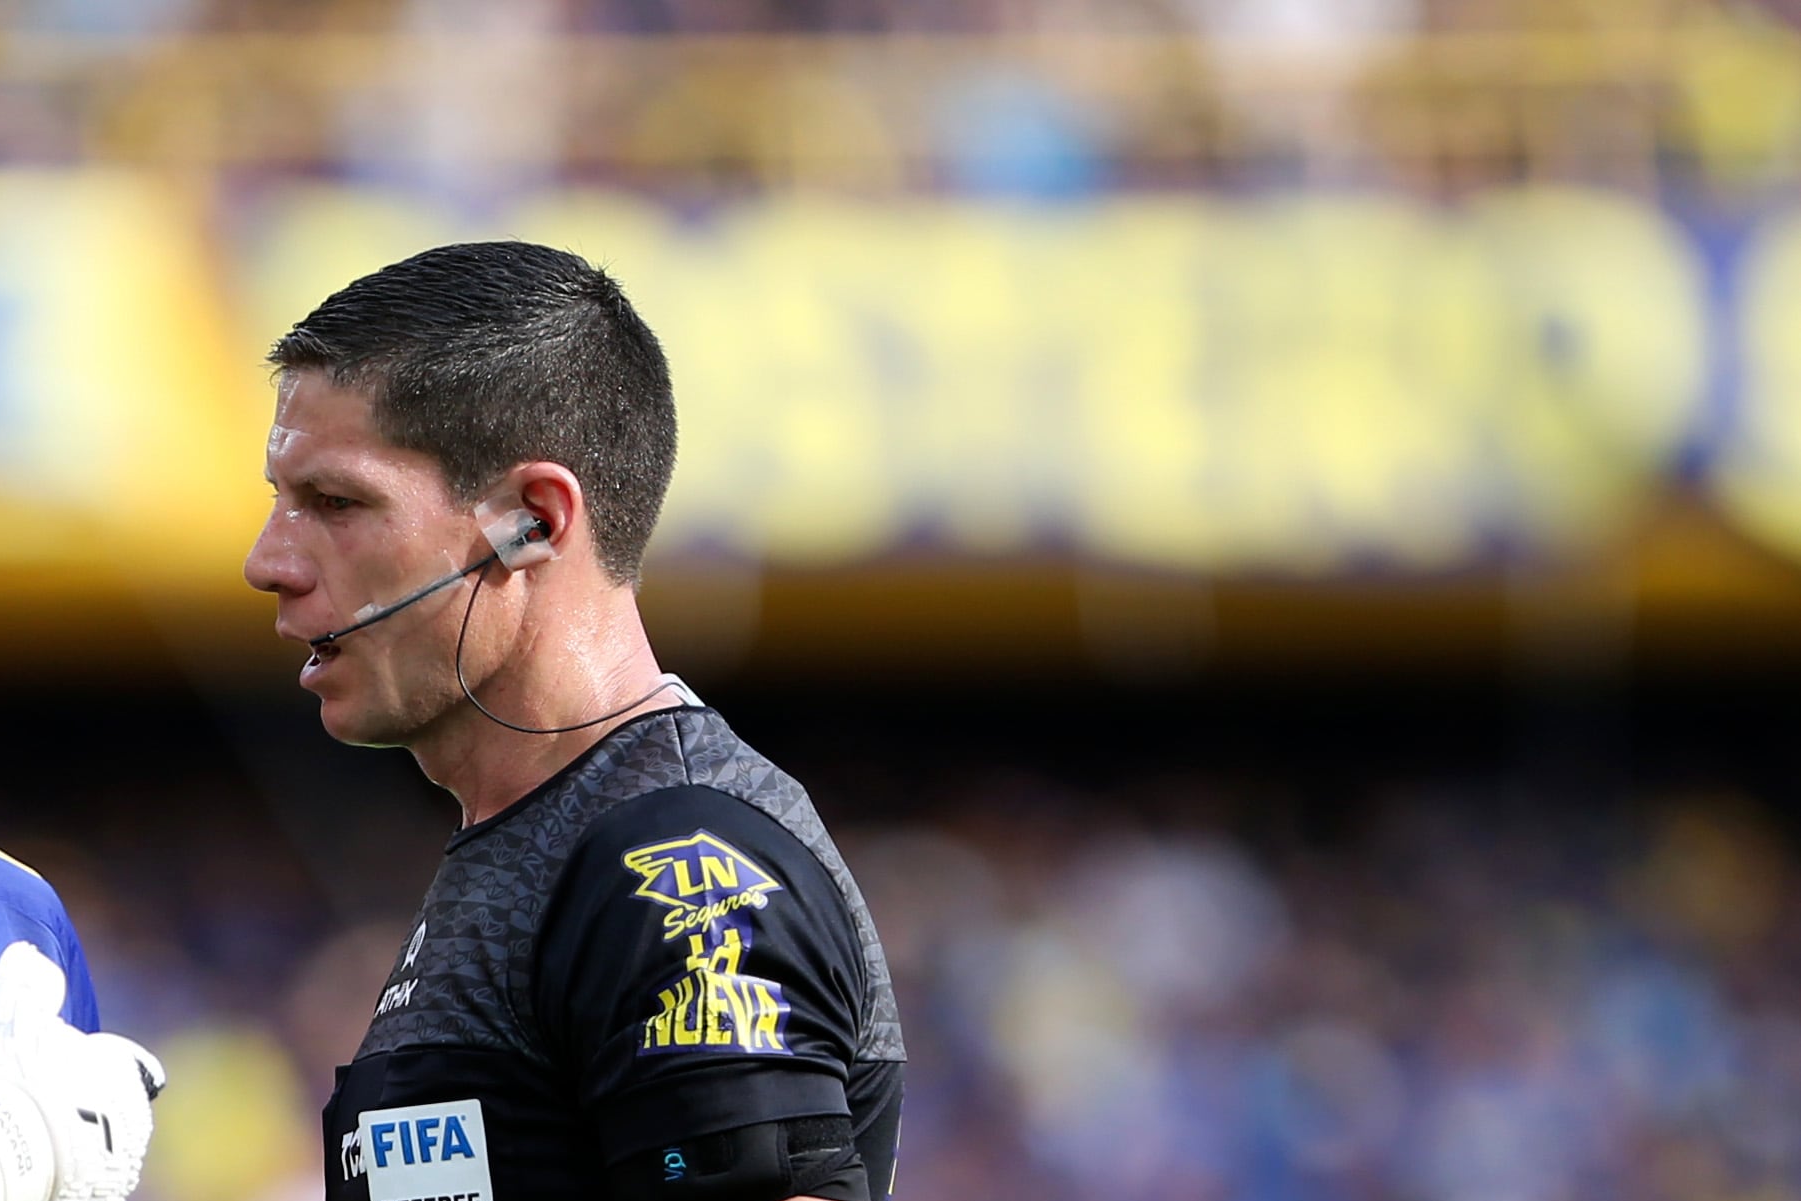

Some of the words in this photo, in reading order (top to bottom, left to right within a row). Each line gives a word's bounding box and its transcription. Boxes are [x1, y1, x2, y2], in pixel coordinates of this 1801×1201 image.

[673, 856, 739, 897] LN
[663, 890, 768, 940] Seguros
[686, 928, 742, 976] LA
[643, 968, 784, 1050] NUEVA
[370, 1115, 476, 1168] FIFA
